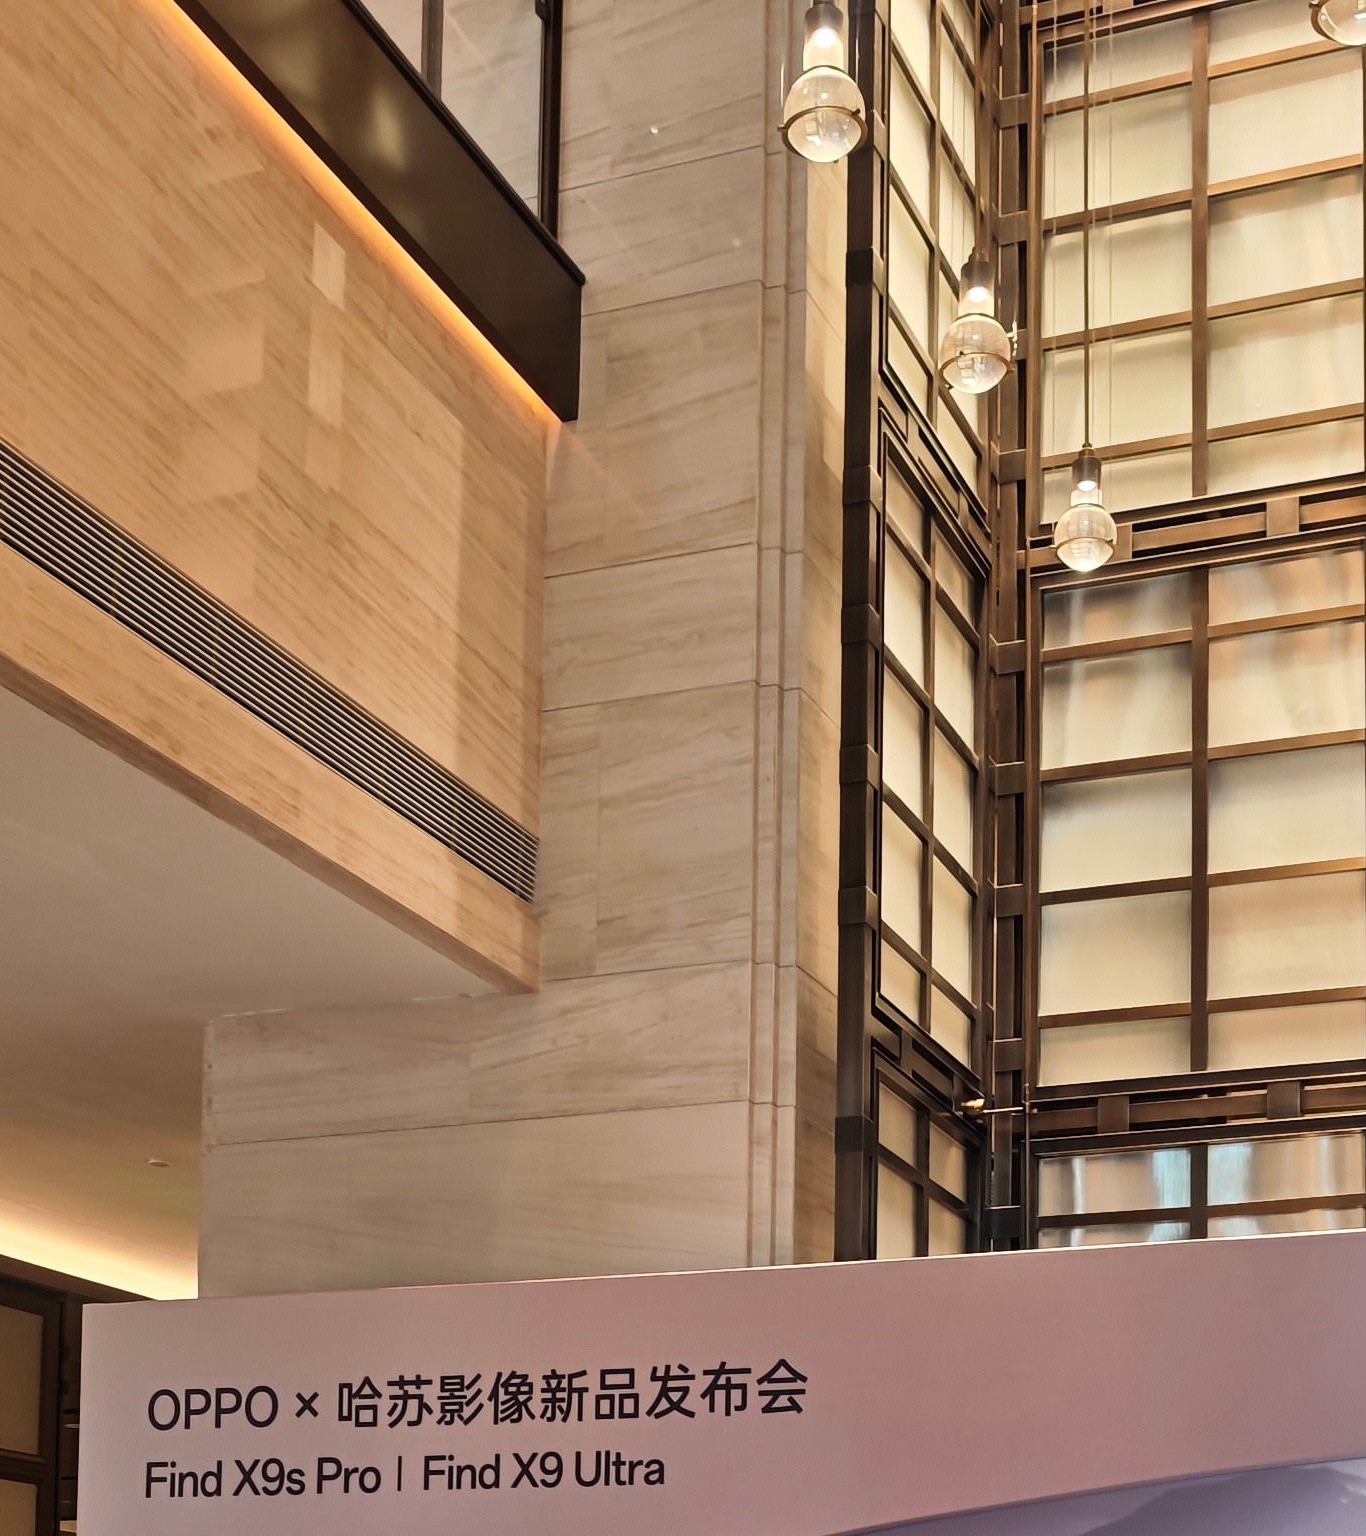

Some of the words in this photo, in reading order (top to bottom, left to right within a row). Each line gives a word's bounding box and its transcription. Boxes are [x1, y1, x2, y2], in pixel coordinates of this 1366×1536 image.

[147, 1386, 279, 1431] OPPO
[337, 1359, 809, 1429] 哈苏影像新品发布会
[145, 1459, 223, 1499] Find
[232, 1457, 306, 1497] X9s
[316, 1456, 382, 1495] Pro
[423, 1453, 501, 1491] Find
[510, 1451, 564, 1489] X9
[574, 1449, 665, 1488] Ultra
